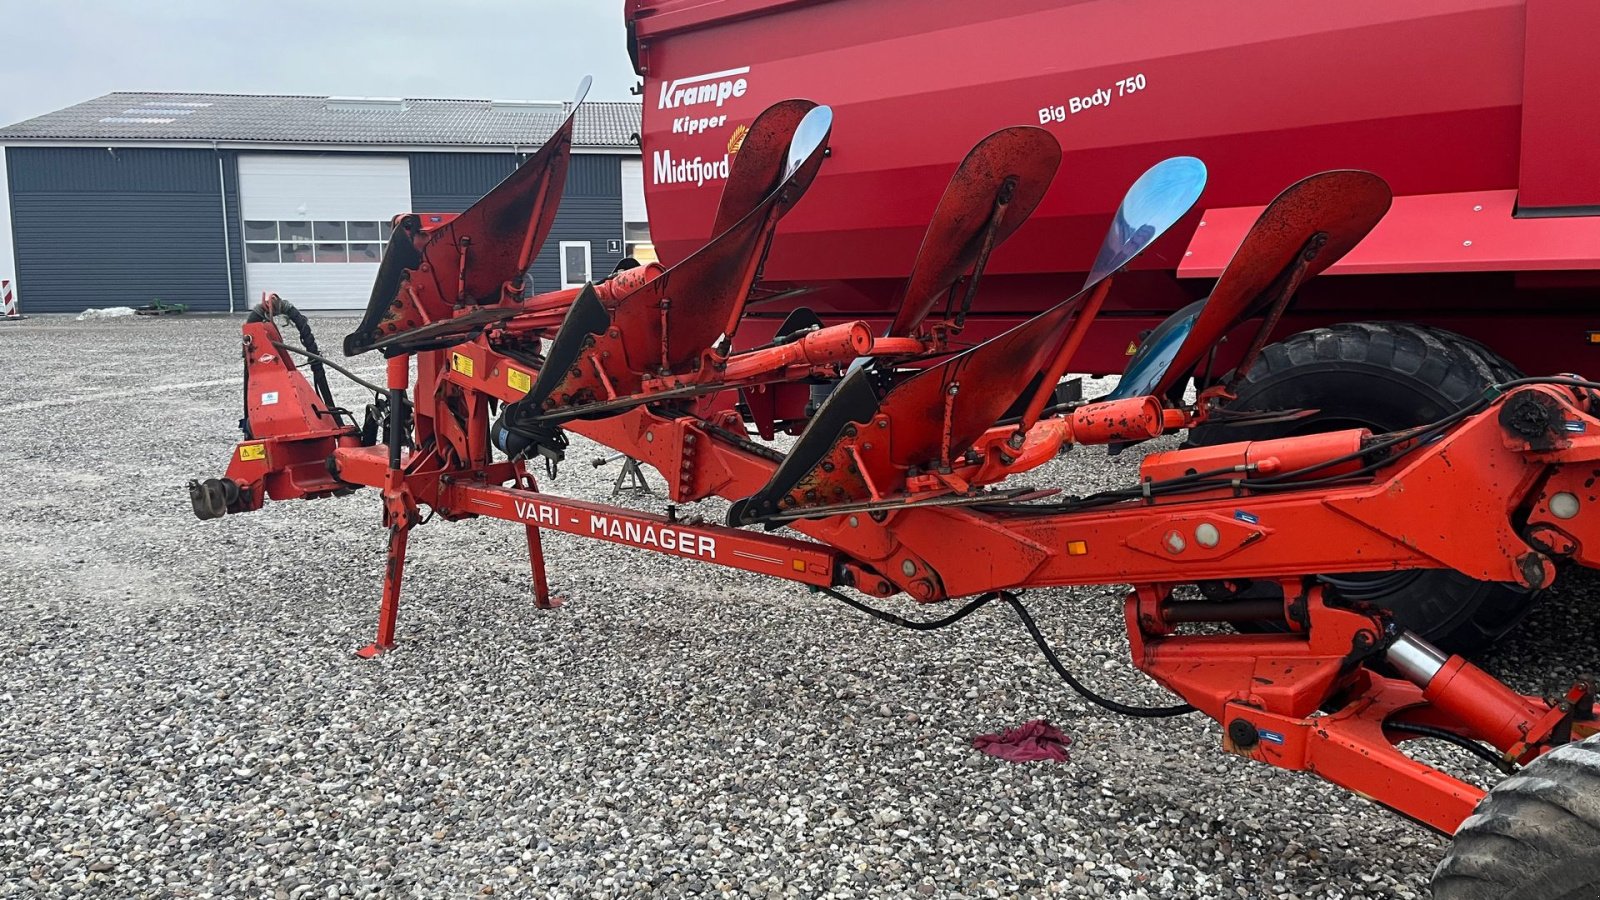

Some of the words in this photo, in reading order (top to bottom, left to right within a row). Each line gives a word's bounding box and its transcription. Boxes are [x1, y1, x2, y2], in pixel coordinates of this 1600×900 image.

[658, 66, 750, 109] Krampe
[1038, 105, 1066, 124] Big
[1068, 88, 1112, 113] Body
[1115, 73, 1146, 97] 750
[673, 115, 727, 135] Kipper
[654, 149, 729, 187] Midtfjord
[514, 500, 560, 526] VARI
[590, 514, 716, 559] MANAGER
